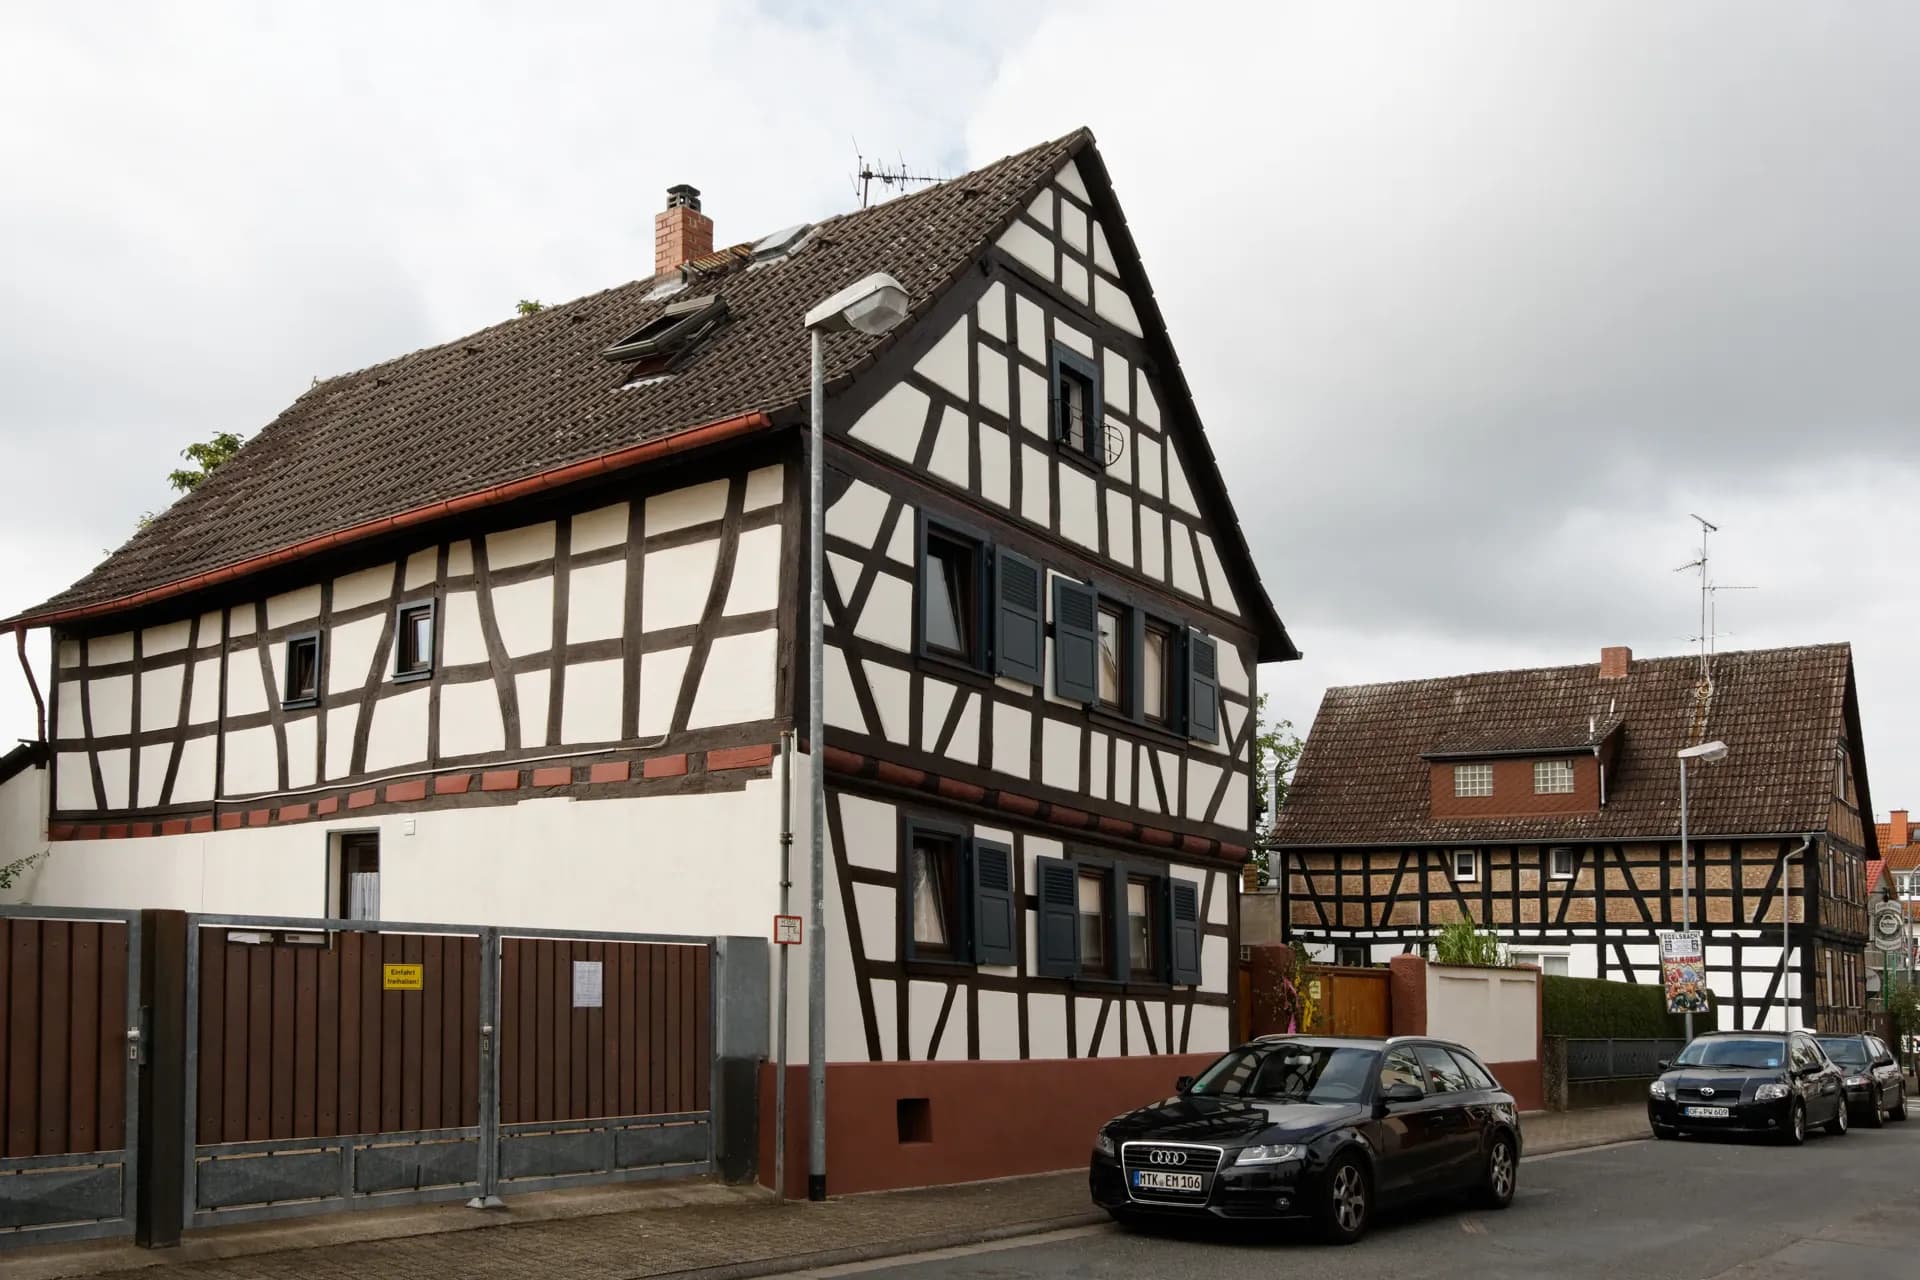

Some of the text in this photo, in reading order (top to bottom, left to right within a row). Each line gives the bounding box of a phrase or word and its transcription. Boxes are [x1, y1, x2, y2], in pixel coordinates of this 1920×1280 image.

[391, 968, 416, 976] Einfahrt
[1140, 1171, 1200, 1189] MTK EM 106
